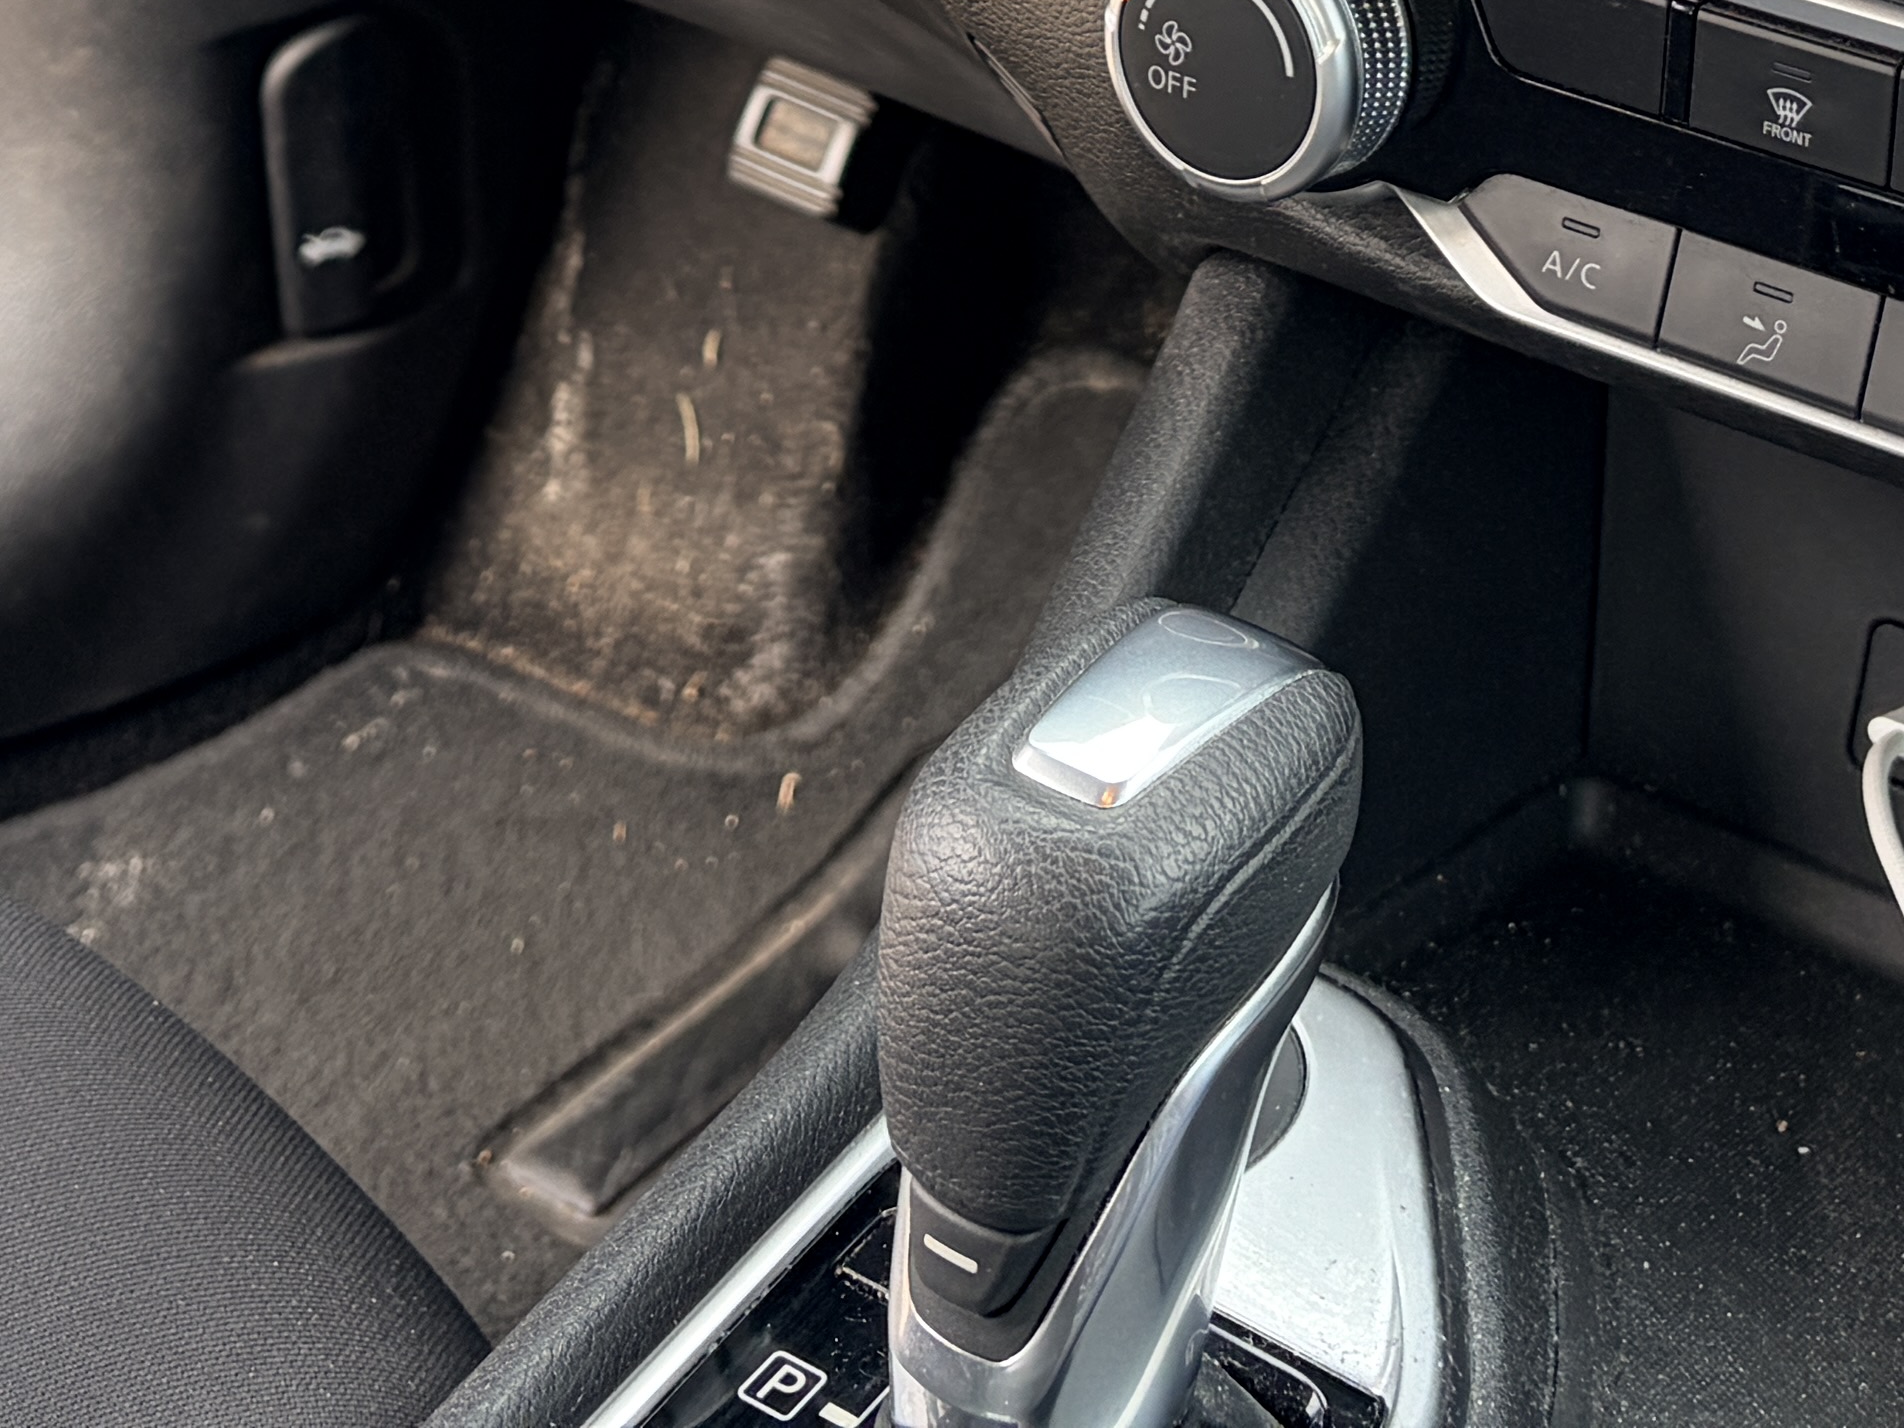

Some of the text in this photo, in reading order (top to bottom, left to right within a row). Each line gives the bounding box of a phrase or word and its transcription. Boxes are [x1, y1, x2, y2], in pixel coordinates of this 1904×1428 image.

[1147, 65, 1197, 99] OFF
[1761, 120, 1813, 148] FRONT
[1541, 249, 1602, 291] A/C
[755, 1363, 807, 1399] P
